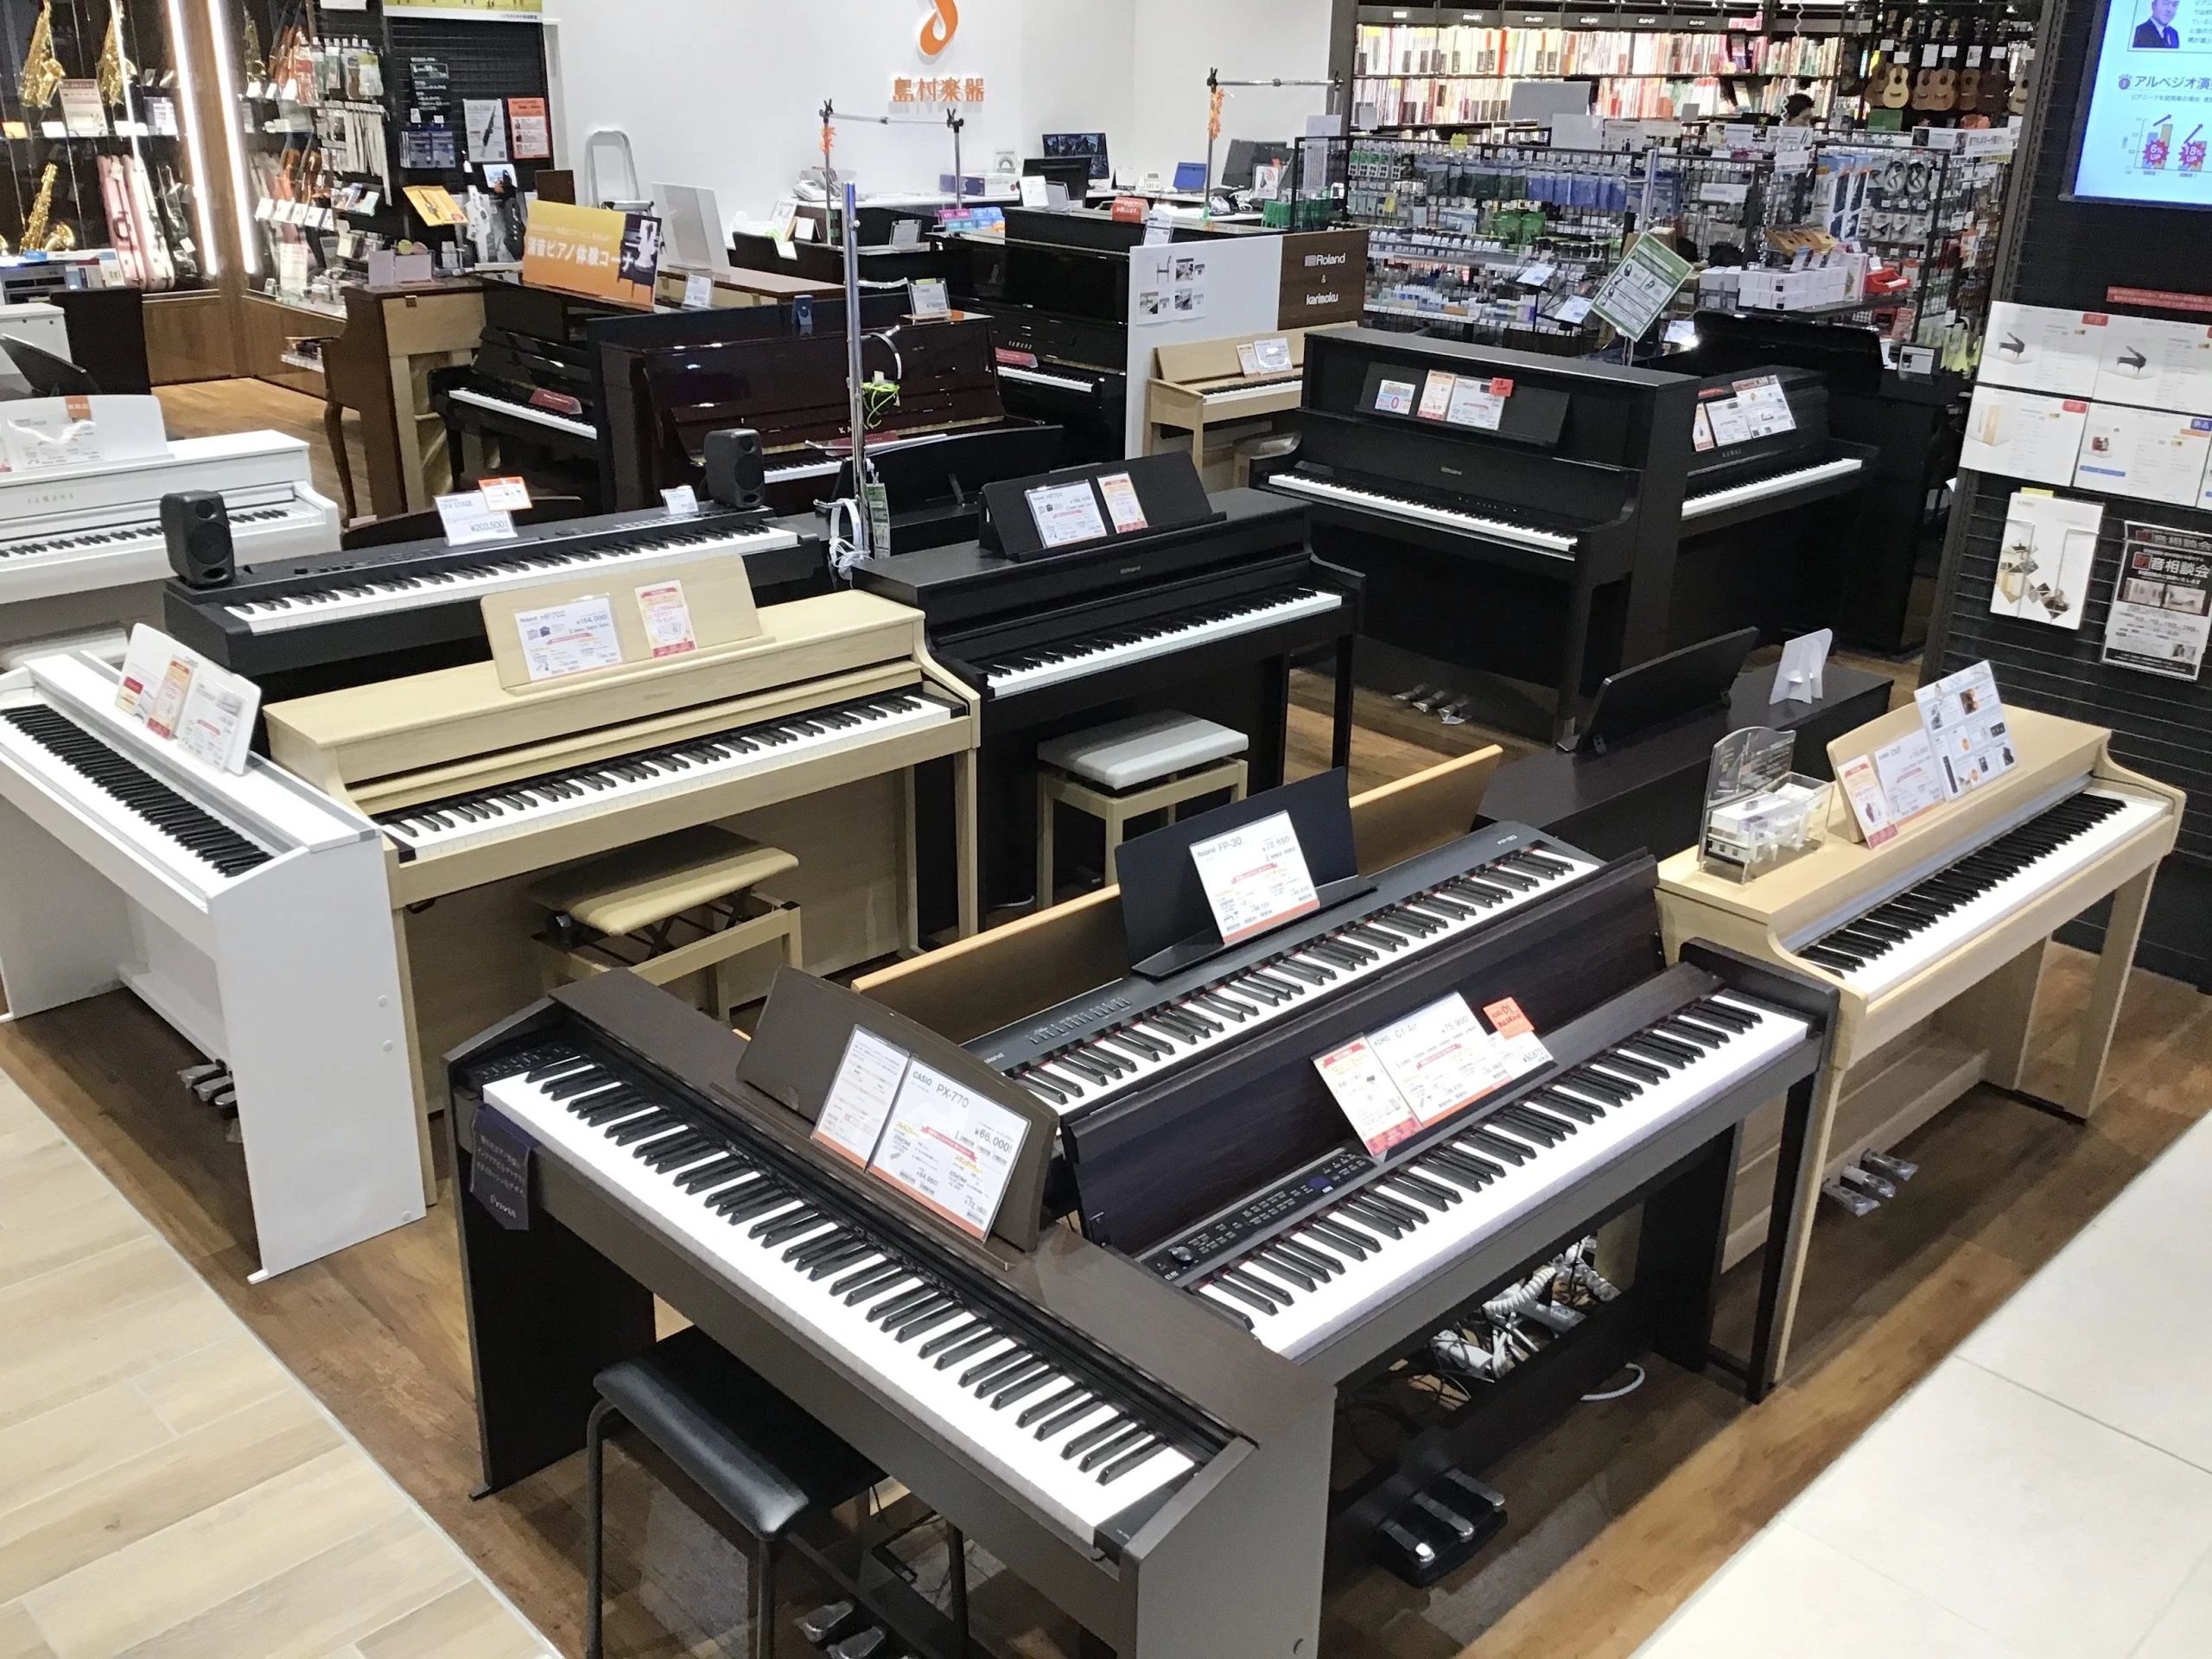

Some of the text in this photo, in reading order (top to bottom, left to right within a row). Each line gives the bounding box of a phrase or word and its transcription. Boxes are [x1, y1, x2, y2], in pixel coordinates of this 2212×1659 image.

[893, 76, 985, 102] 島村楽器
[2150, 144, 2163, 154] 6%
[2183, 146, 2202, 156] 18%
[1316, 252, 1346, 266] Roland
[1320, 274, 1327, 283] &
[1306, 291, 1339, 306] karimoku
[540, 610, 566, 620] HP702
[1218, 836, 1243, 852] FP-30
[912, 1071, 969, 1109] CASIO PX-770
